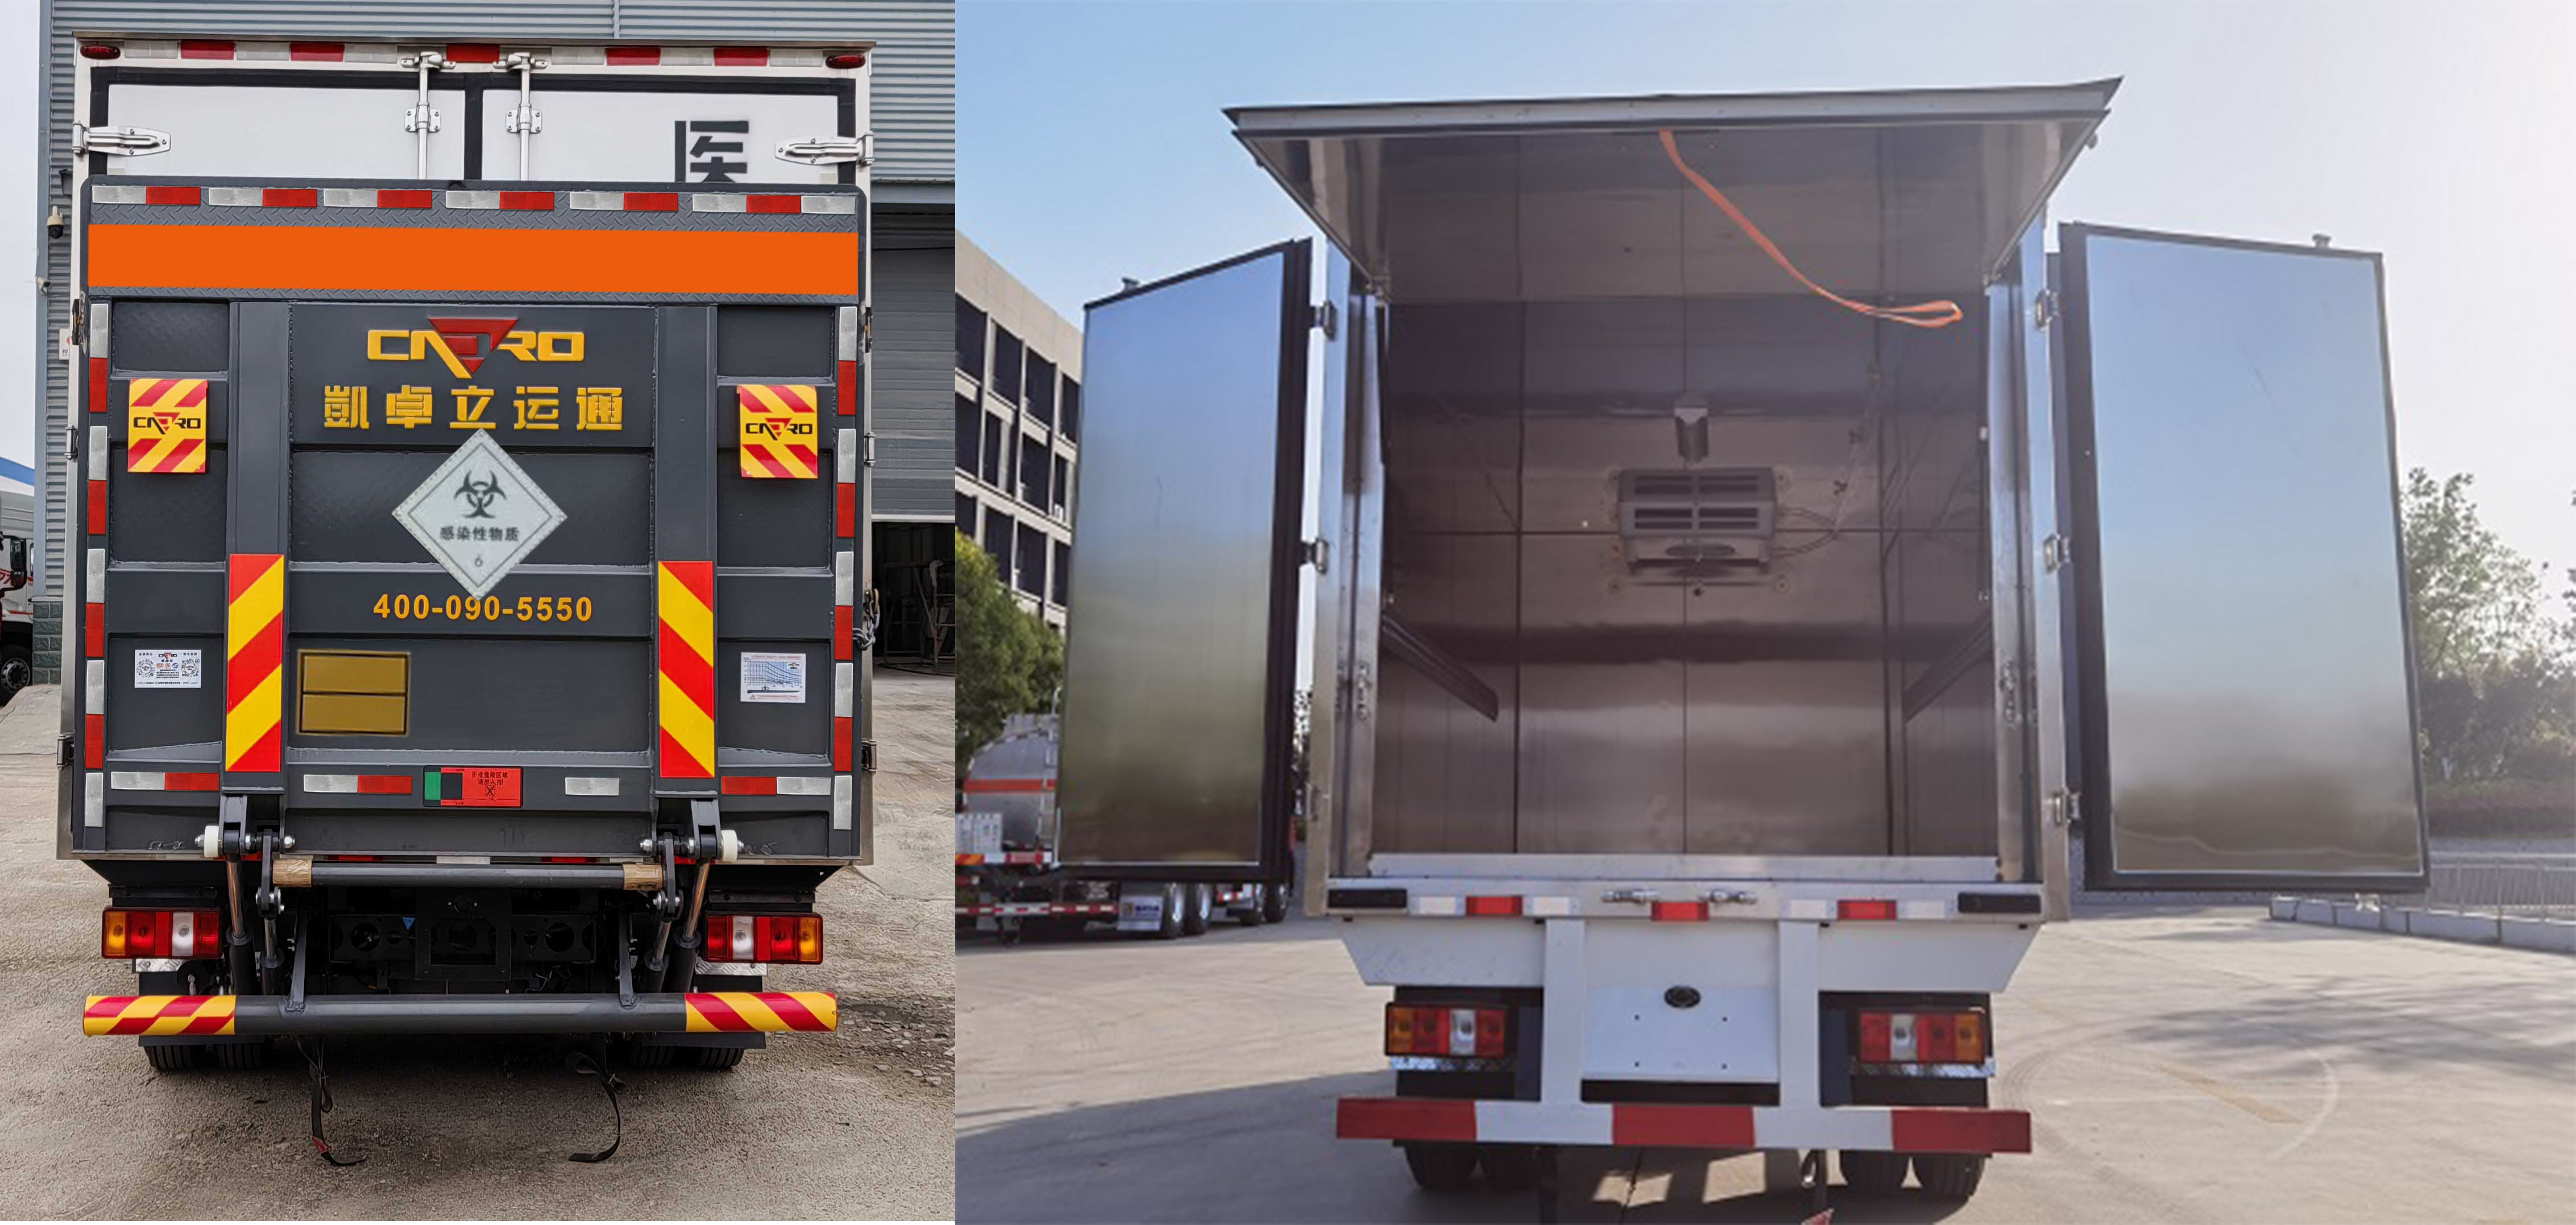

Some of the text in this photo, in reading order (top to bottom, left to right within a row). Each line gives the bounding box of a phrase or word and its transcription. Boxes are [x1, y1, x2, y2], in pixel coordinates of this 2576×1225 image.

[674, 121, 749, 182] 医
[439, 526, 520, 542] 感染性物质
[474, 553, 483, 567] 6
[373, 593, 592, 622] 400-090-5550
